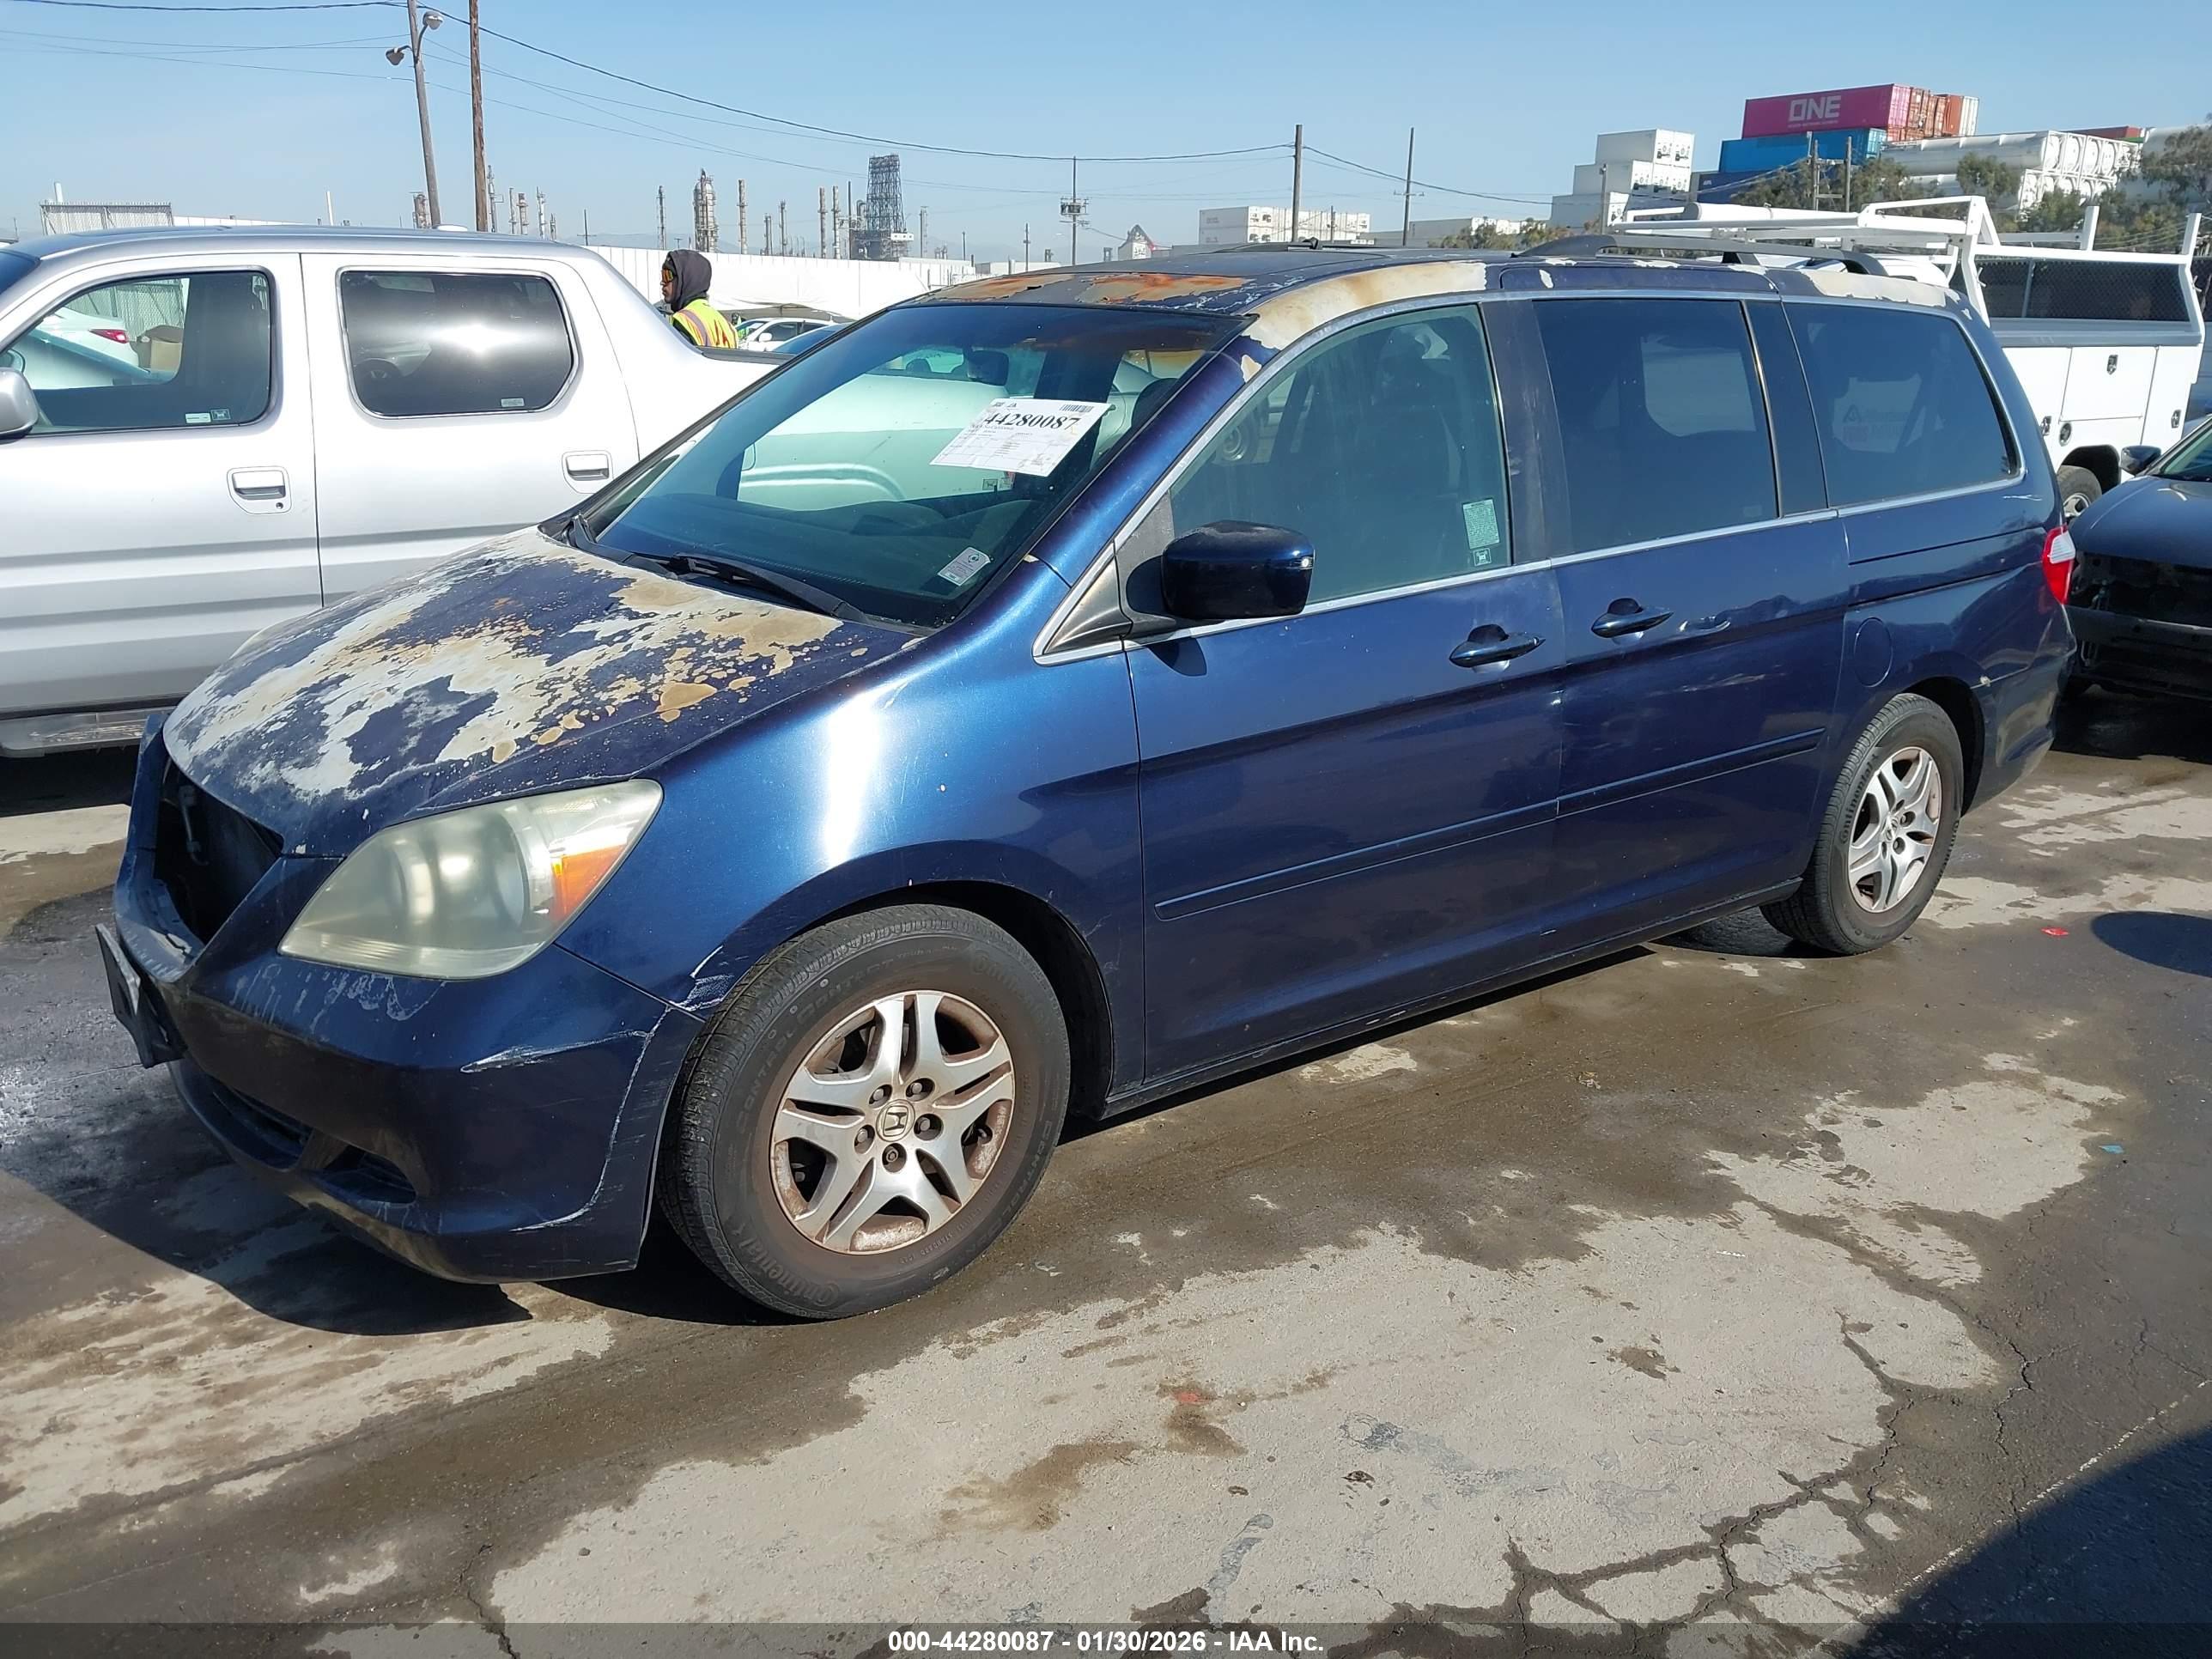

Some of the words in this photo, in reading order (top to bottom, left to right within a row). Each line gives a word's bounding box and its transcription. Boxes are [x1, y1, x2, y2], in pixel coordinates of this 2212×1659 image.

[1788, 95, 1842, 122] ONE
[985, 411, 1080, 430] 44280087
[1840, 762, 1872, 844] Continental
[738, 1236, 840, 1307] Continental
